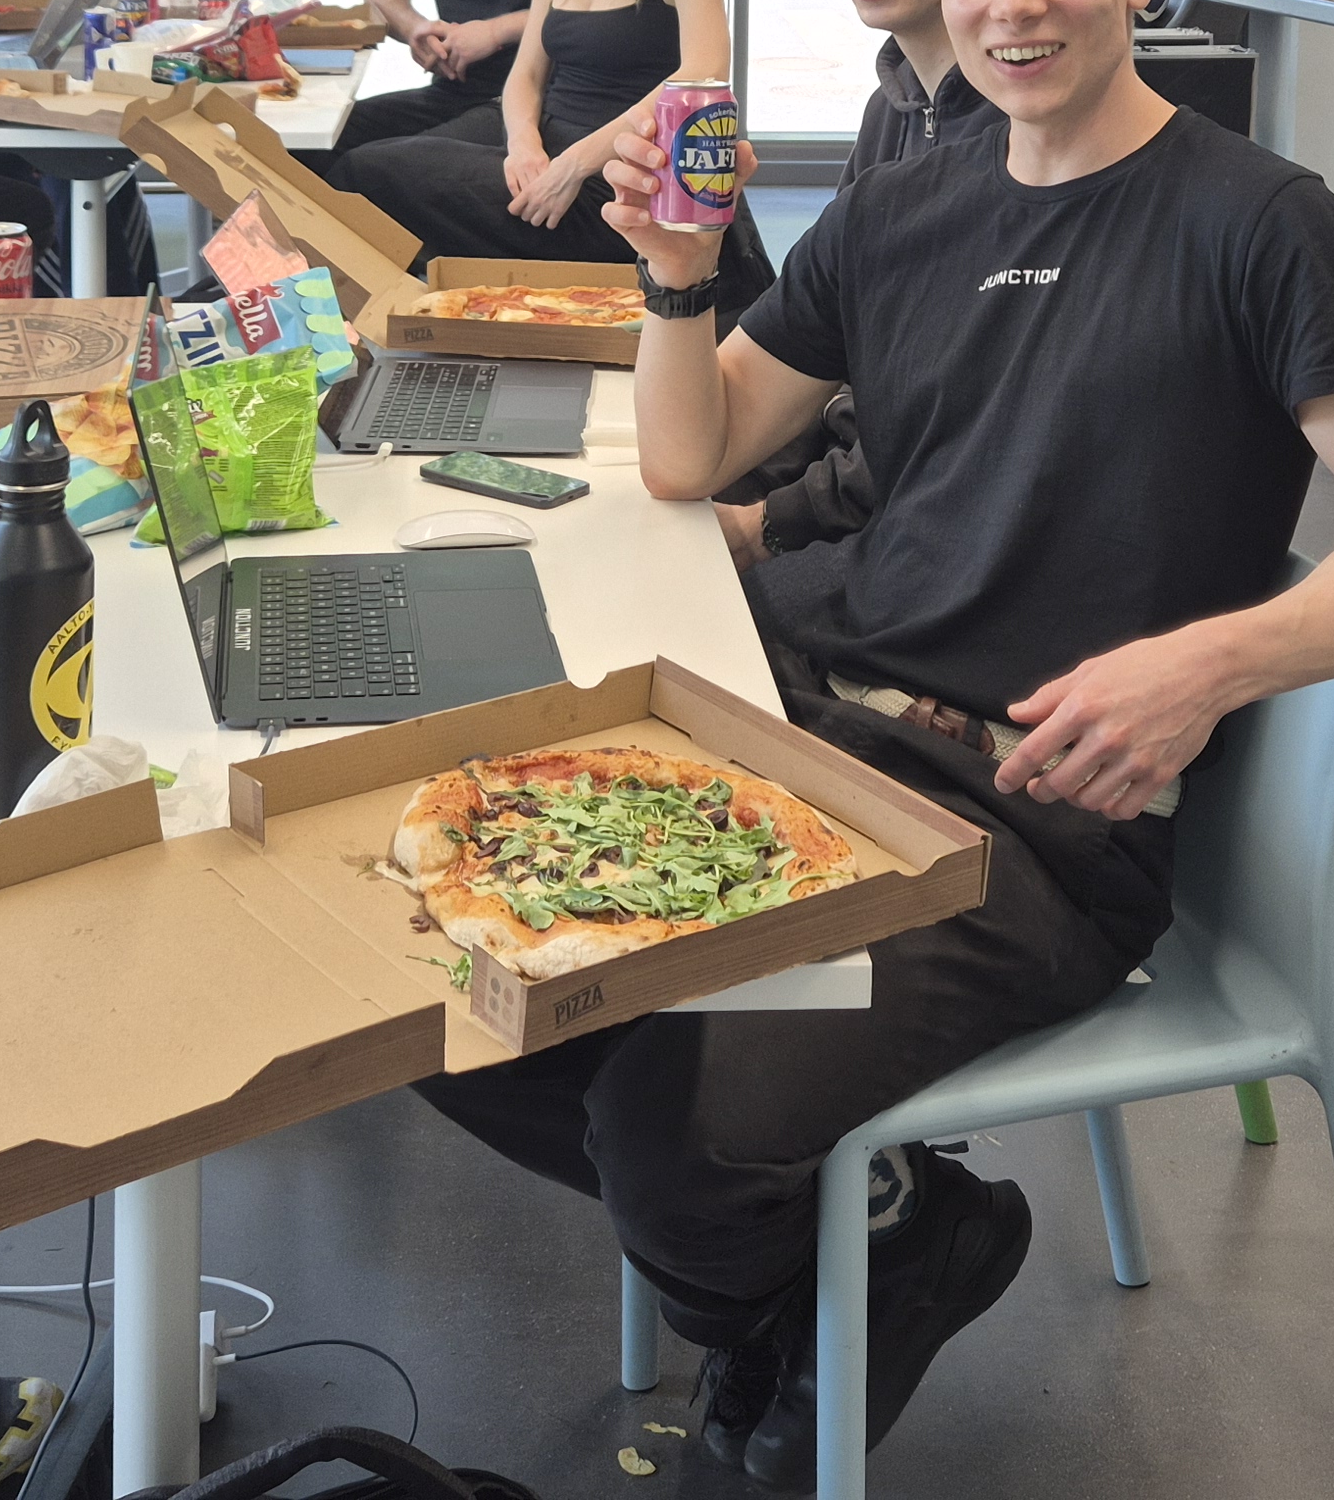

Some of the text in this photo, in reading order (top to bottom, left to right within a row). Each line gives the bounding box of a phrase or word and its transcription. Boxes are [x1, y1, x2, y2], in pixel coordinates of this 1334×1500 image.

[978, 267, 1061, 292] JUNCTION
[404, 328, 435, 343] PIZZA
[234, 608, 252, 651] JUNCTION
[555, 984, 605, 1026] PIZZA
